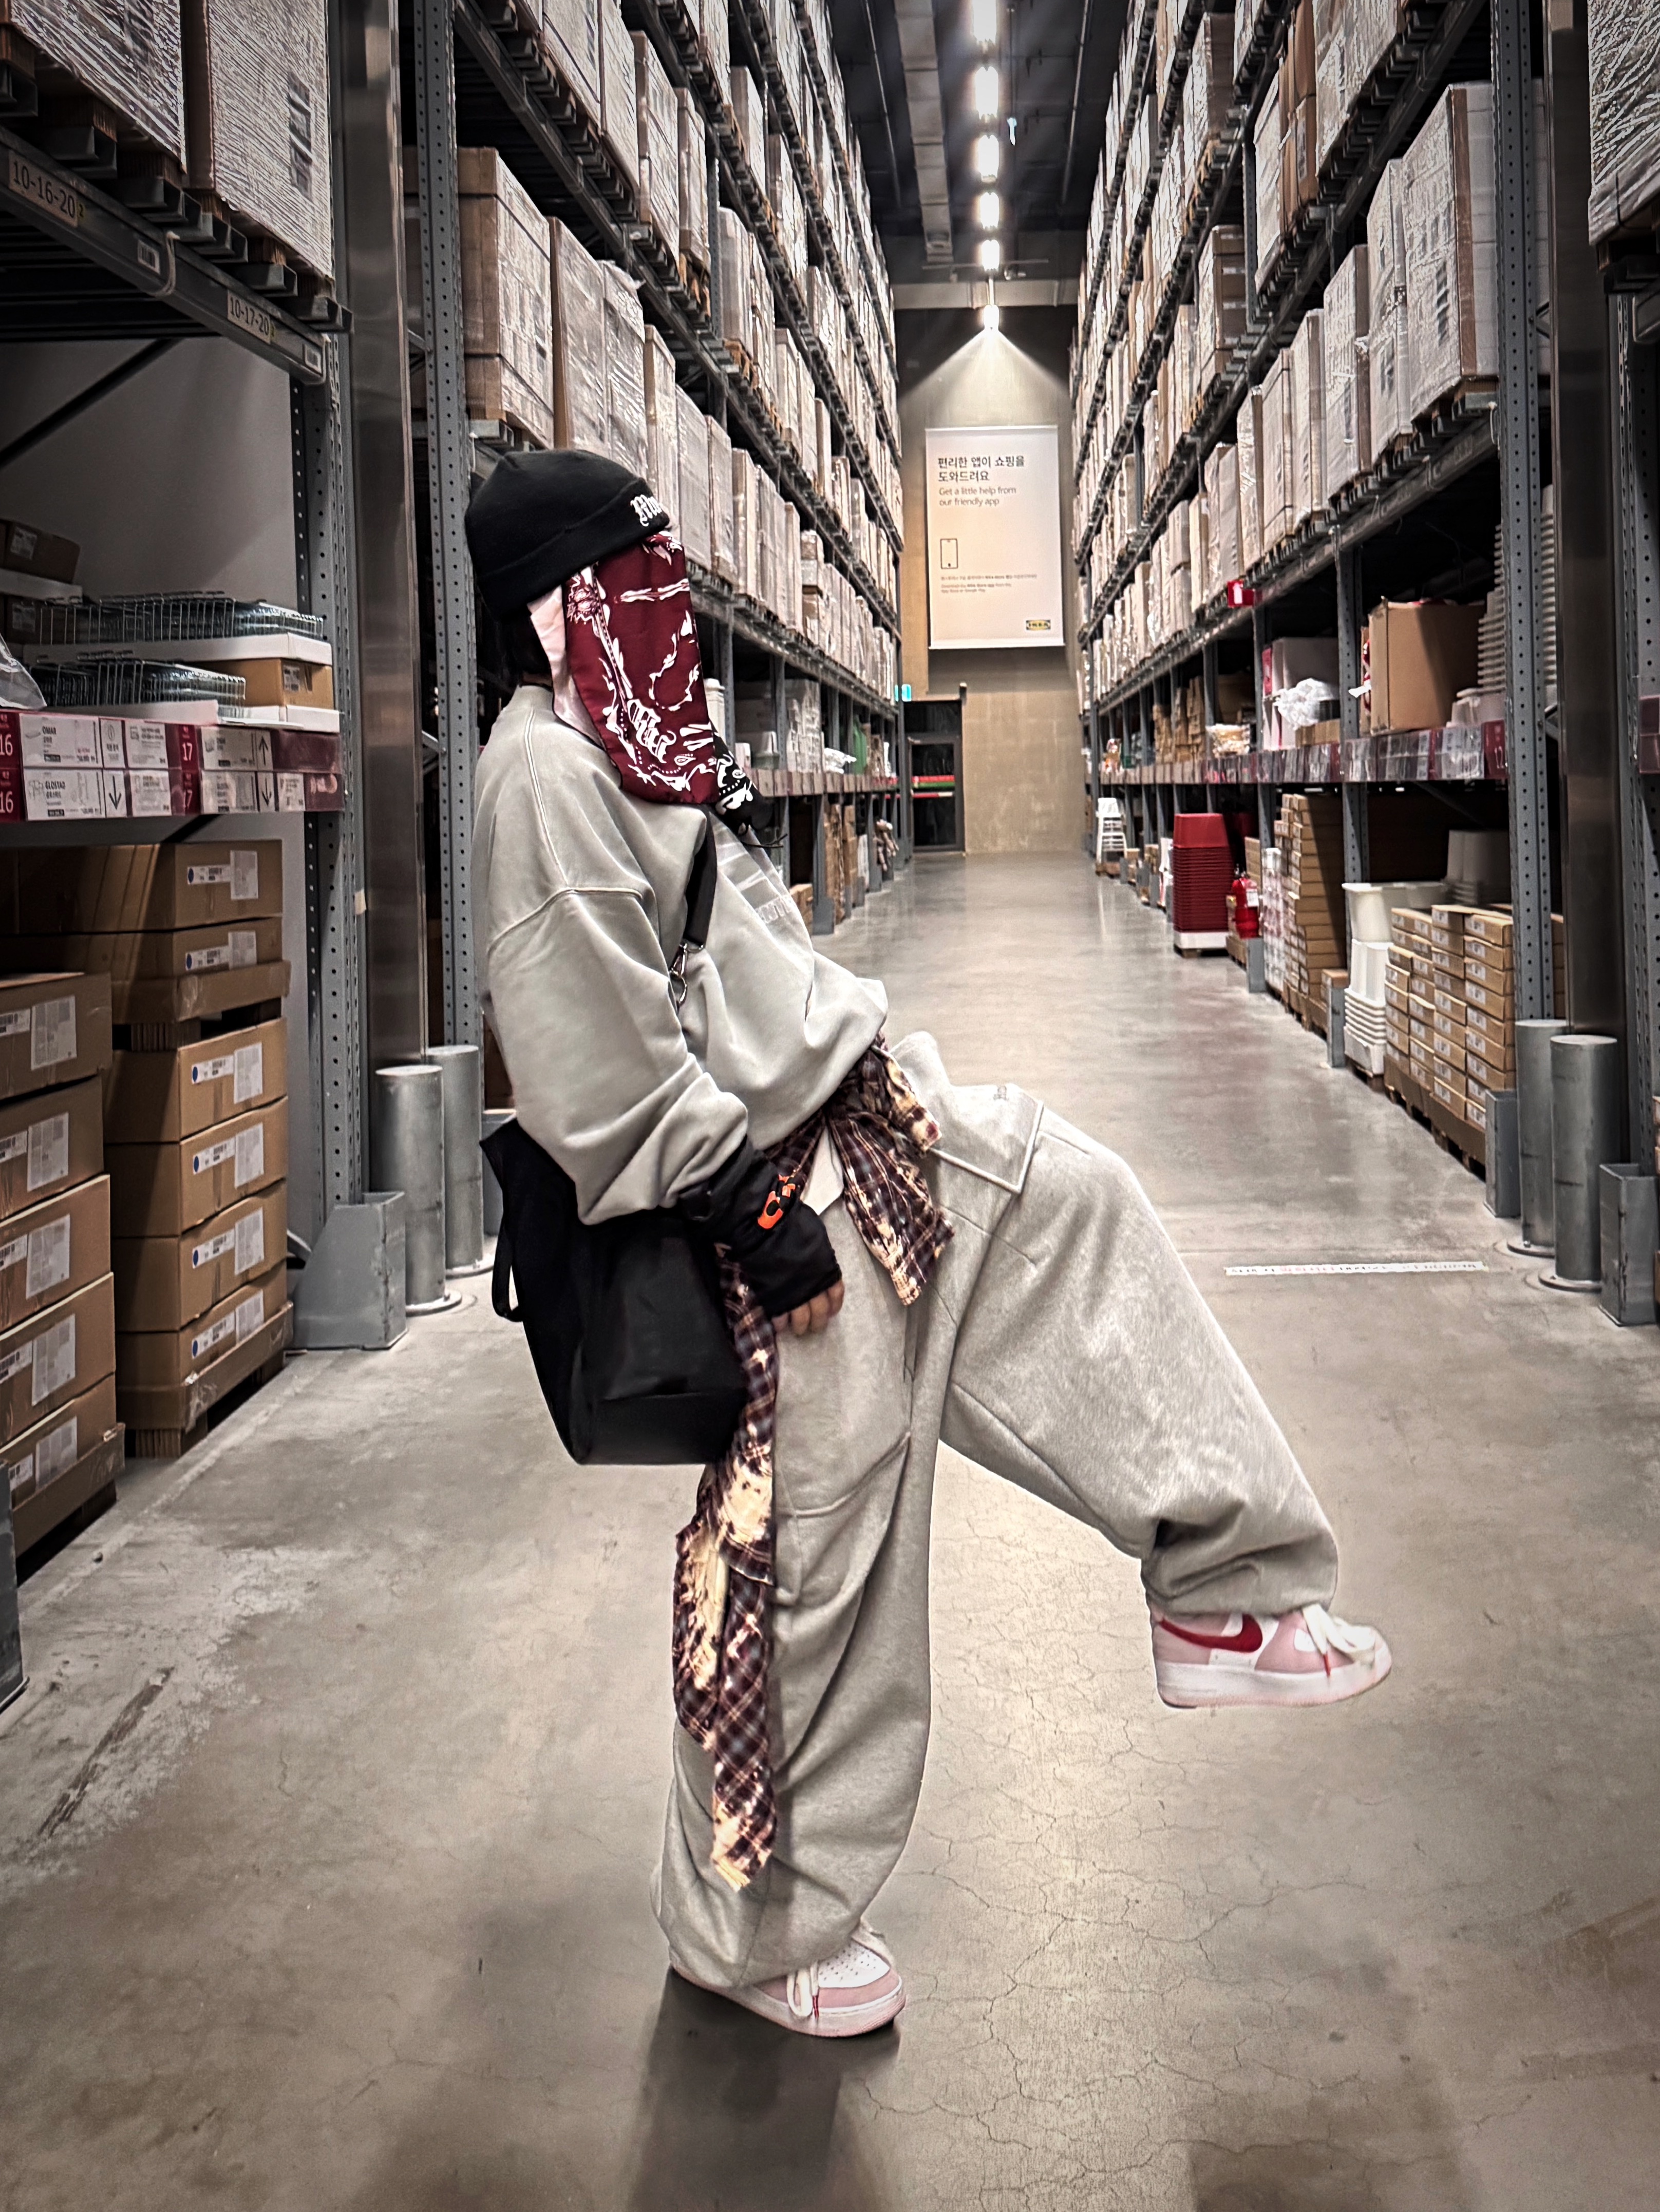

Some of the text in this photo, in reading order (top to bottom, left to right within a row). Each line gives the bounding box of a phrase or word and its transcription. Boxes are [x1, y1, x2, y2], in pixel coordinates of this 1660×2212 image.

[14, 160, 75, 218] 10-16-20
[230, 296, 270, 336] 10-17-20
[938, 455, 1024, 469] 편리한 앱이 쇼핑을
[938, 470, 990, 482] 도와드려요
[939, 487, 952, 495] Get
[979, 486, 995, 495] help
[998, 486, 1016, 494] from
[954, 497, 983, 507] friendly
[985, 498, 999, 506] app
[0, 733, 13, 756] 16
[182, 742, 193, 761] 17
[0, 791, 14, 814] 16
